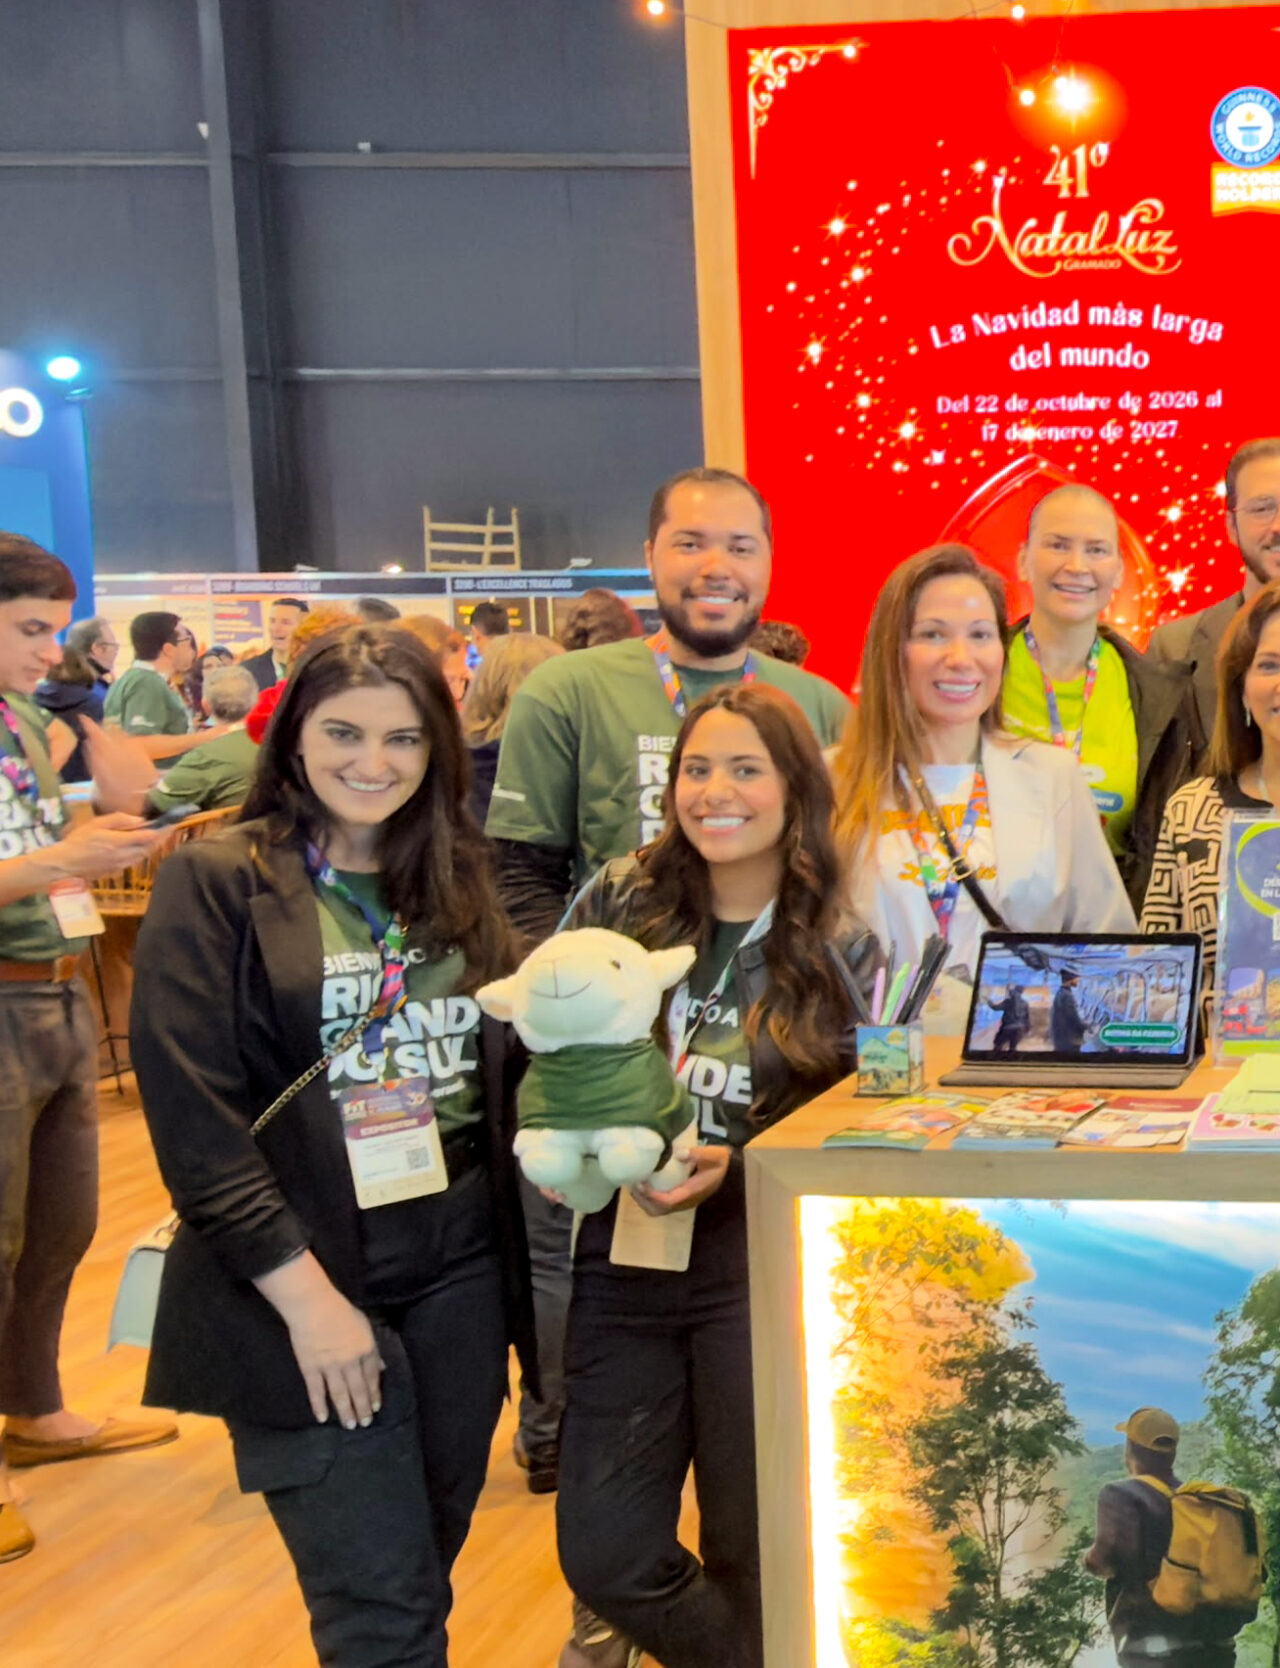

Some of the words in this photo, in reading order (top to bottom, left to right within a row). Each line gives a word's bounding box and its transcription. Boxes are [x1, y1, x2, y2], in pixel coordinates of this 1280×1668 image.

[947, 166, 1110, 279] Natal
[1106, 197, 1182, 276] Luz
[929, 315, 967, 349] La
[971, 299, 1080, 338] Navidad
[1151, 303, 1224, 345] larga
[1009, 341, 1052, 372] del
[1059, 342, 1150, 370] mundo
[936, 395, 970, 414] Del
[974, 395, 999, 413] 22
[1004, 393, 1029, 412] de
[1034, 392, 1111, 412] octubre
[1117, 391, 1142, 410] de
[1148, 391, 1198, 409] 2026
[1204, 389, 1223, 408] al
[981, 423, 999, 442] 17
[1039, 424, 1093, 442] enero
[1099, 421, 1123, 440] de
[1130, 420, 1179, 439] 2027
[1261, 888, 1273, 897] EN
[394, 1036, 477, 1080] SUL
